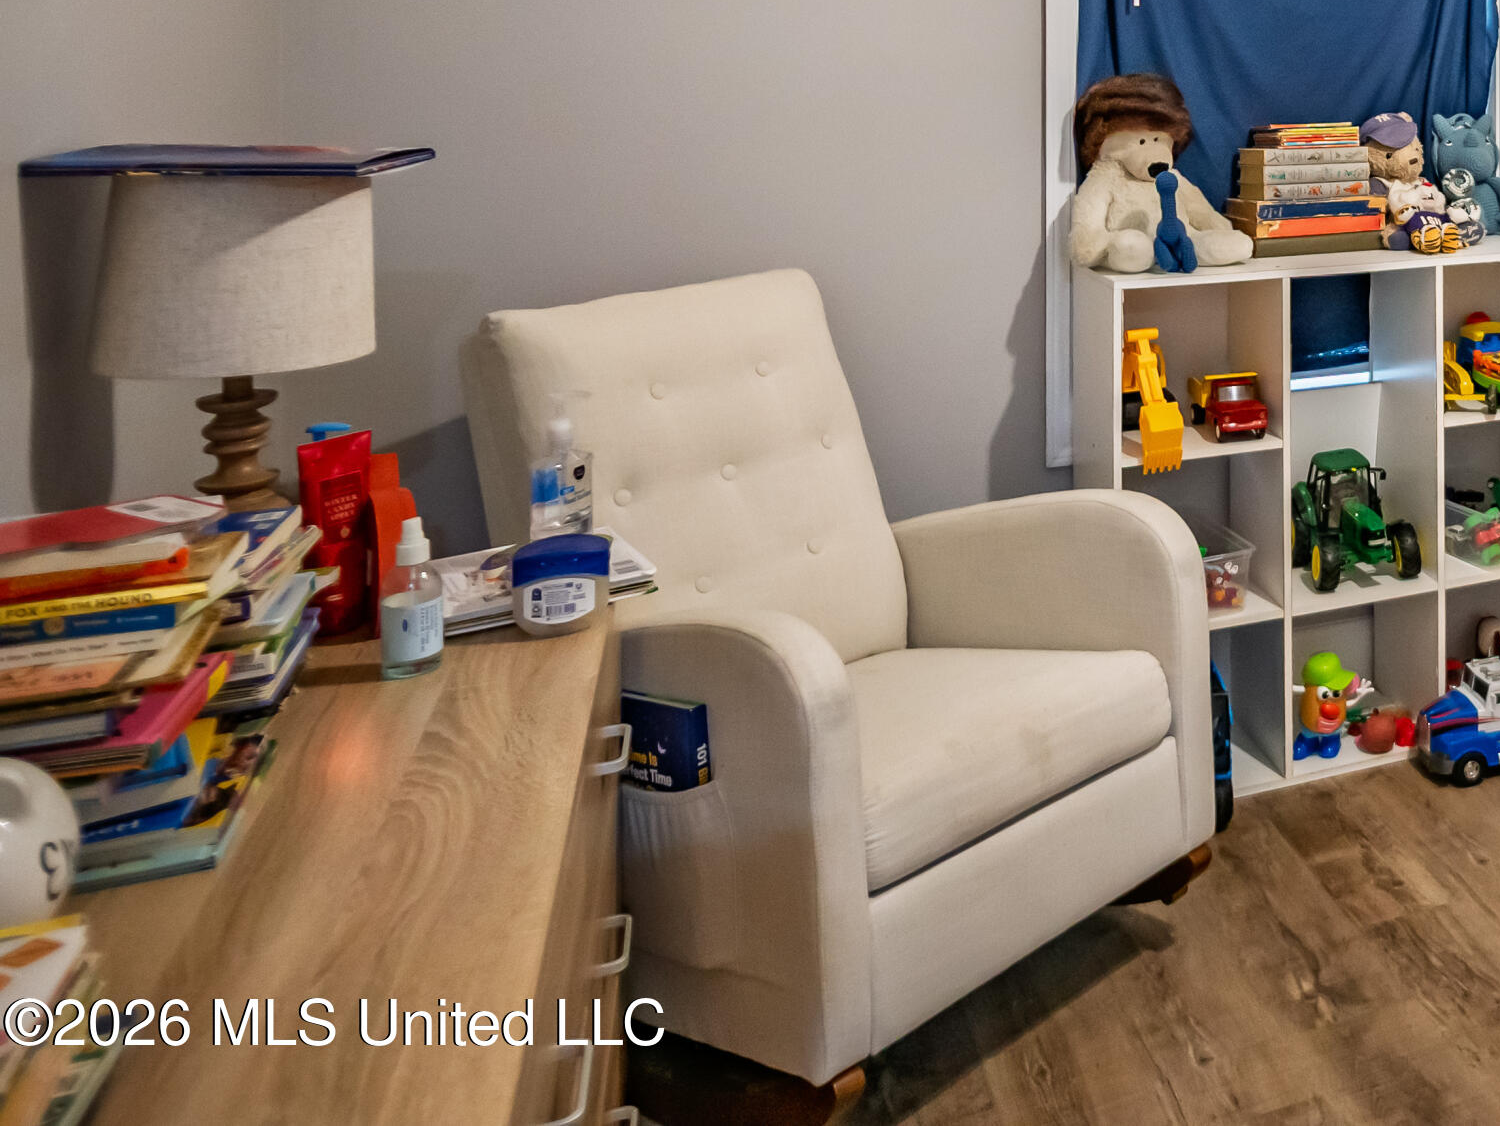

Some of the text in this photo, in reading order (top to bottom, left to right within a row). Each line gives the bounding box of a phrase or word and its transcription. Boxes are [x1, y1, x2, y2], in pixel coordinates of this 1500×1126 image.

[5, 606, 38, 620] FOX
[94, 592, 153, 610] HOUND
[649, 768, 673, 787] Time
